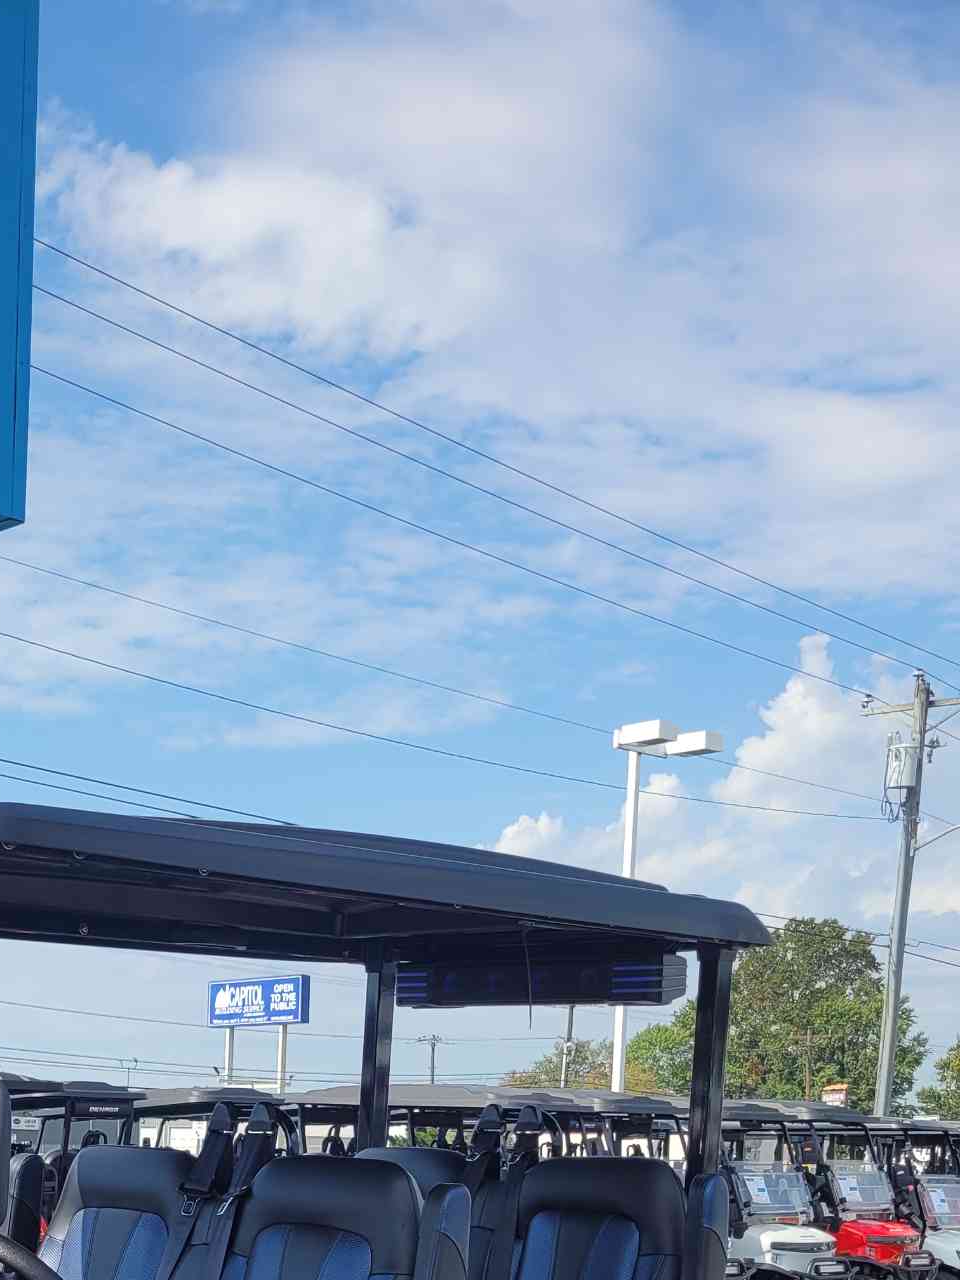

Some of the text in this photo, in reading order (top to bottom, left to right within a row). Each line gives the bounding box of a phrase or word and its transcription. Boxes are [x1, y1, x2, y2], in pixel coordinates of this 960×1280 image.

[273, 983, 294, 993] OPEN
[229, 985, 264, 1007] CAPITOL
[270, 992, 296, 1002] TO THE
[270, 1001, 296, 1011] PUBLIC
